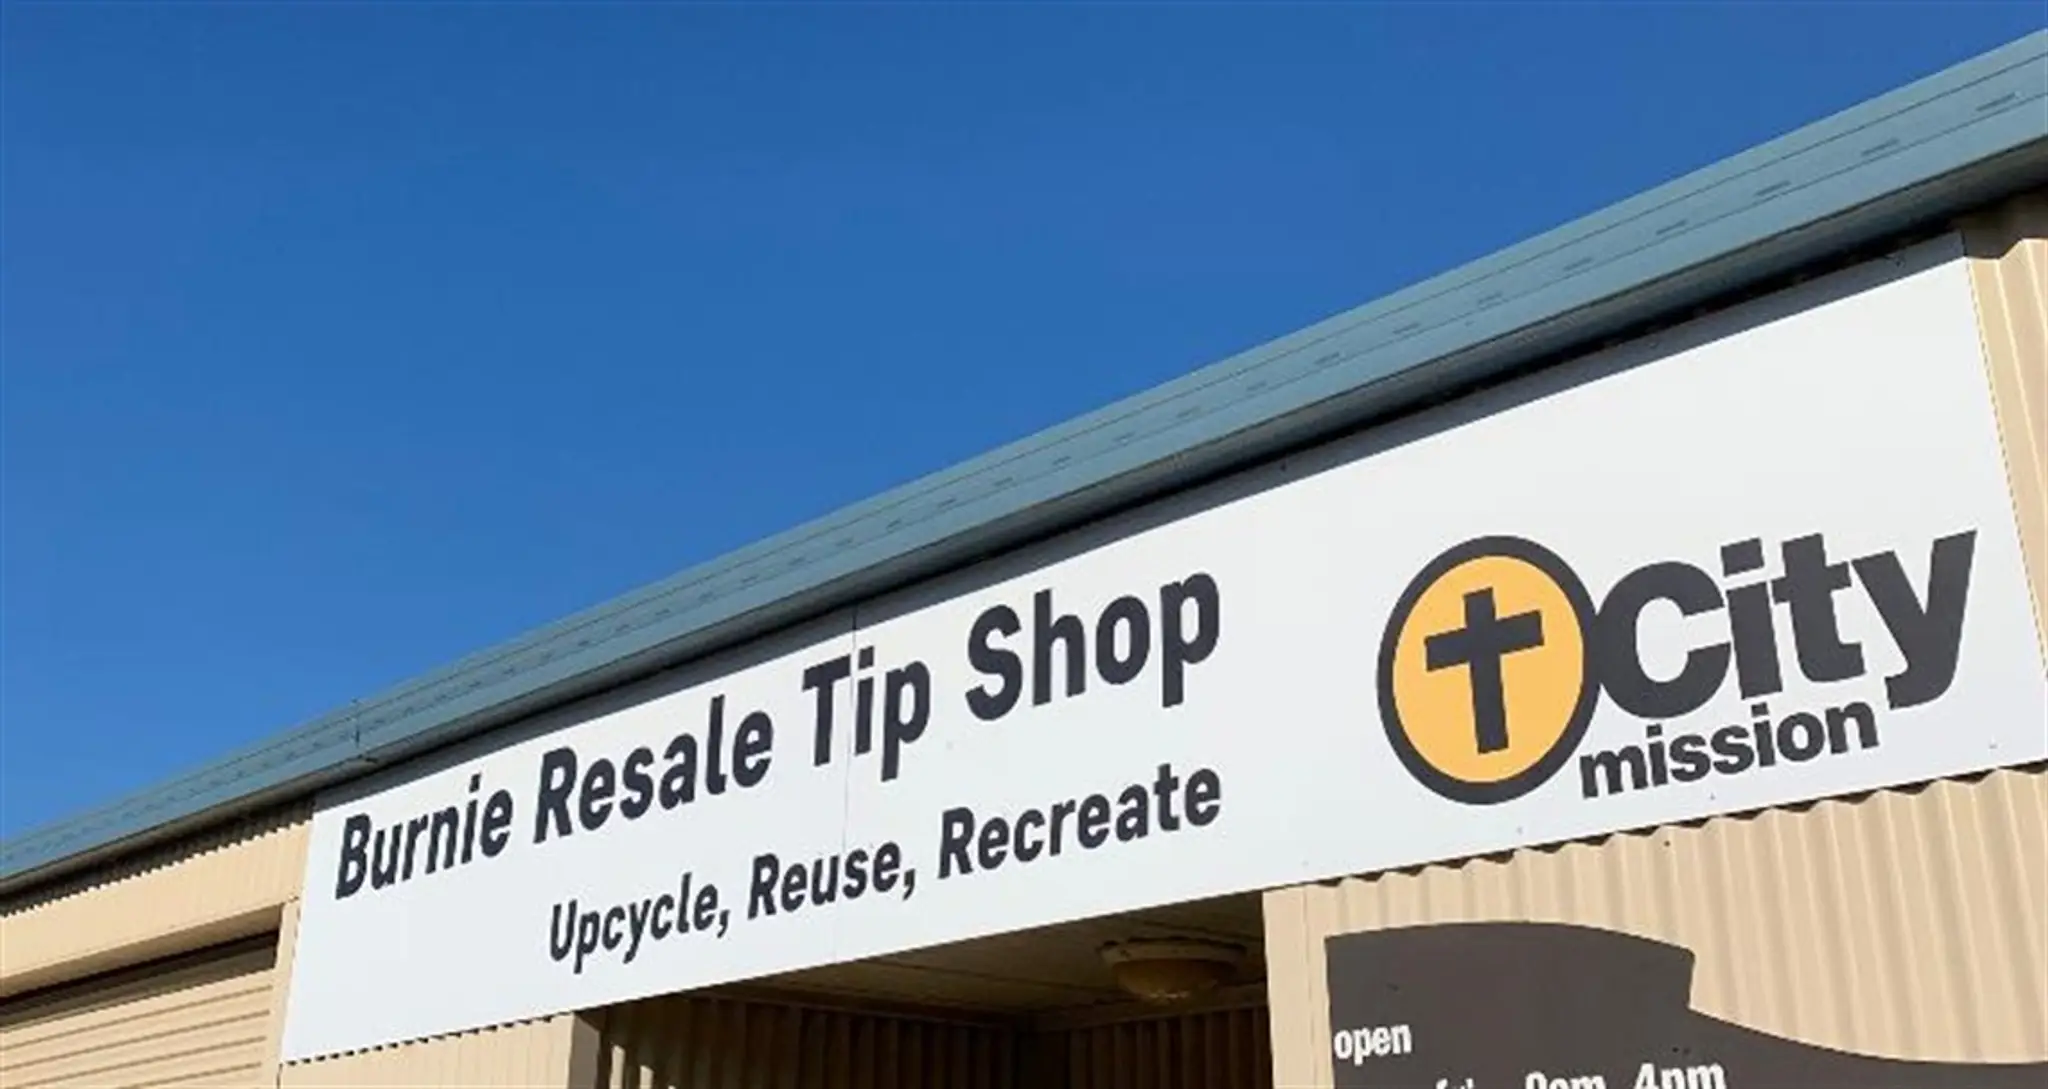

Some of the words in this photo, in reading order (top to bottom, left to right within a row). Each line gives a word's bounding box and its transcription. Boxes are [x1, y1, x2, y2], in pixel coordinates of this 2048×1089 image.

[1597, 530, 1977, 719] City
[335, 773, 513, 900] Burnie
[533, 693, 774, 844] Resale
[801, 645, 931, 783] Tip
[965, 573, 1220, 721] Shop
[1579, 701, 1879, 799] mission
[550, 872, 731, 975] Upcycle,
[747, 841, 916, 920] Reuse,
[938, 763, 1221, 880] Recreate
[1333, 1024, 1412, 1066] open
